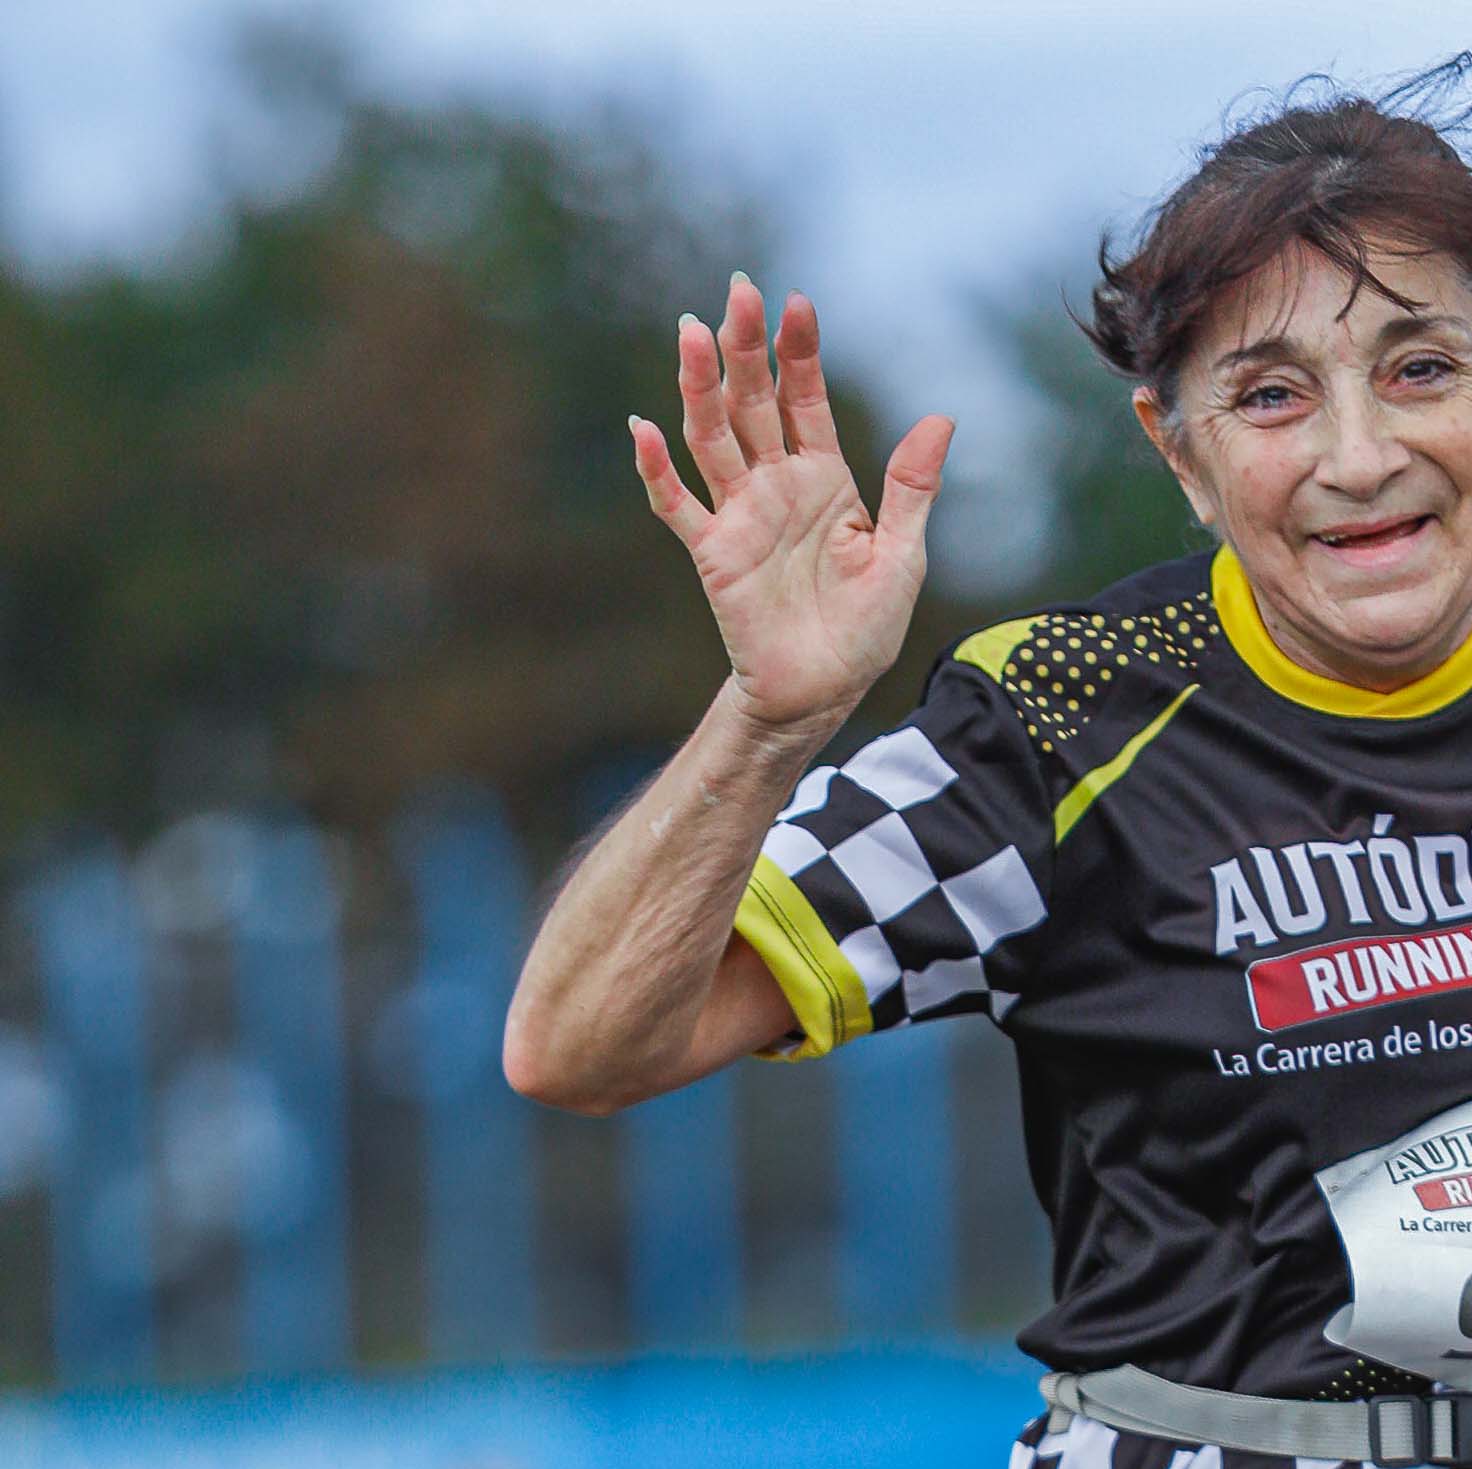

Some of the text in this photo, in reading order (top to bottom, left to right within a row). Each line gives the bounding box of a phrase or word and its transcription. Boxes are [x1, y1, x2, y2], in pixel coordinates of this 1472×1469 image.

[1213, 1048, 1250, 1076] La
[1256, 1026, 1375, 1073] Carrera
[1383, 1025, 1422, 1057] de
[1400, 1217, 1419, 1232] La
